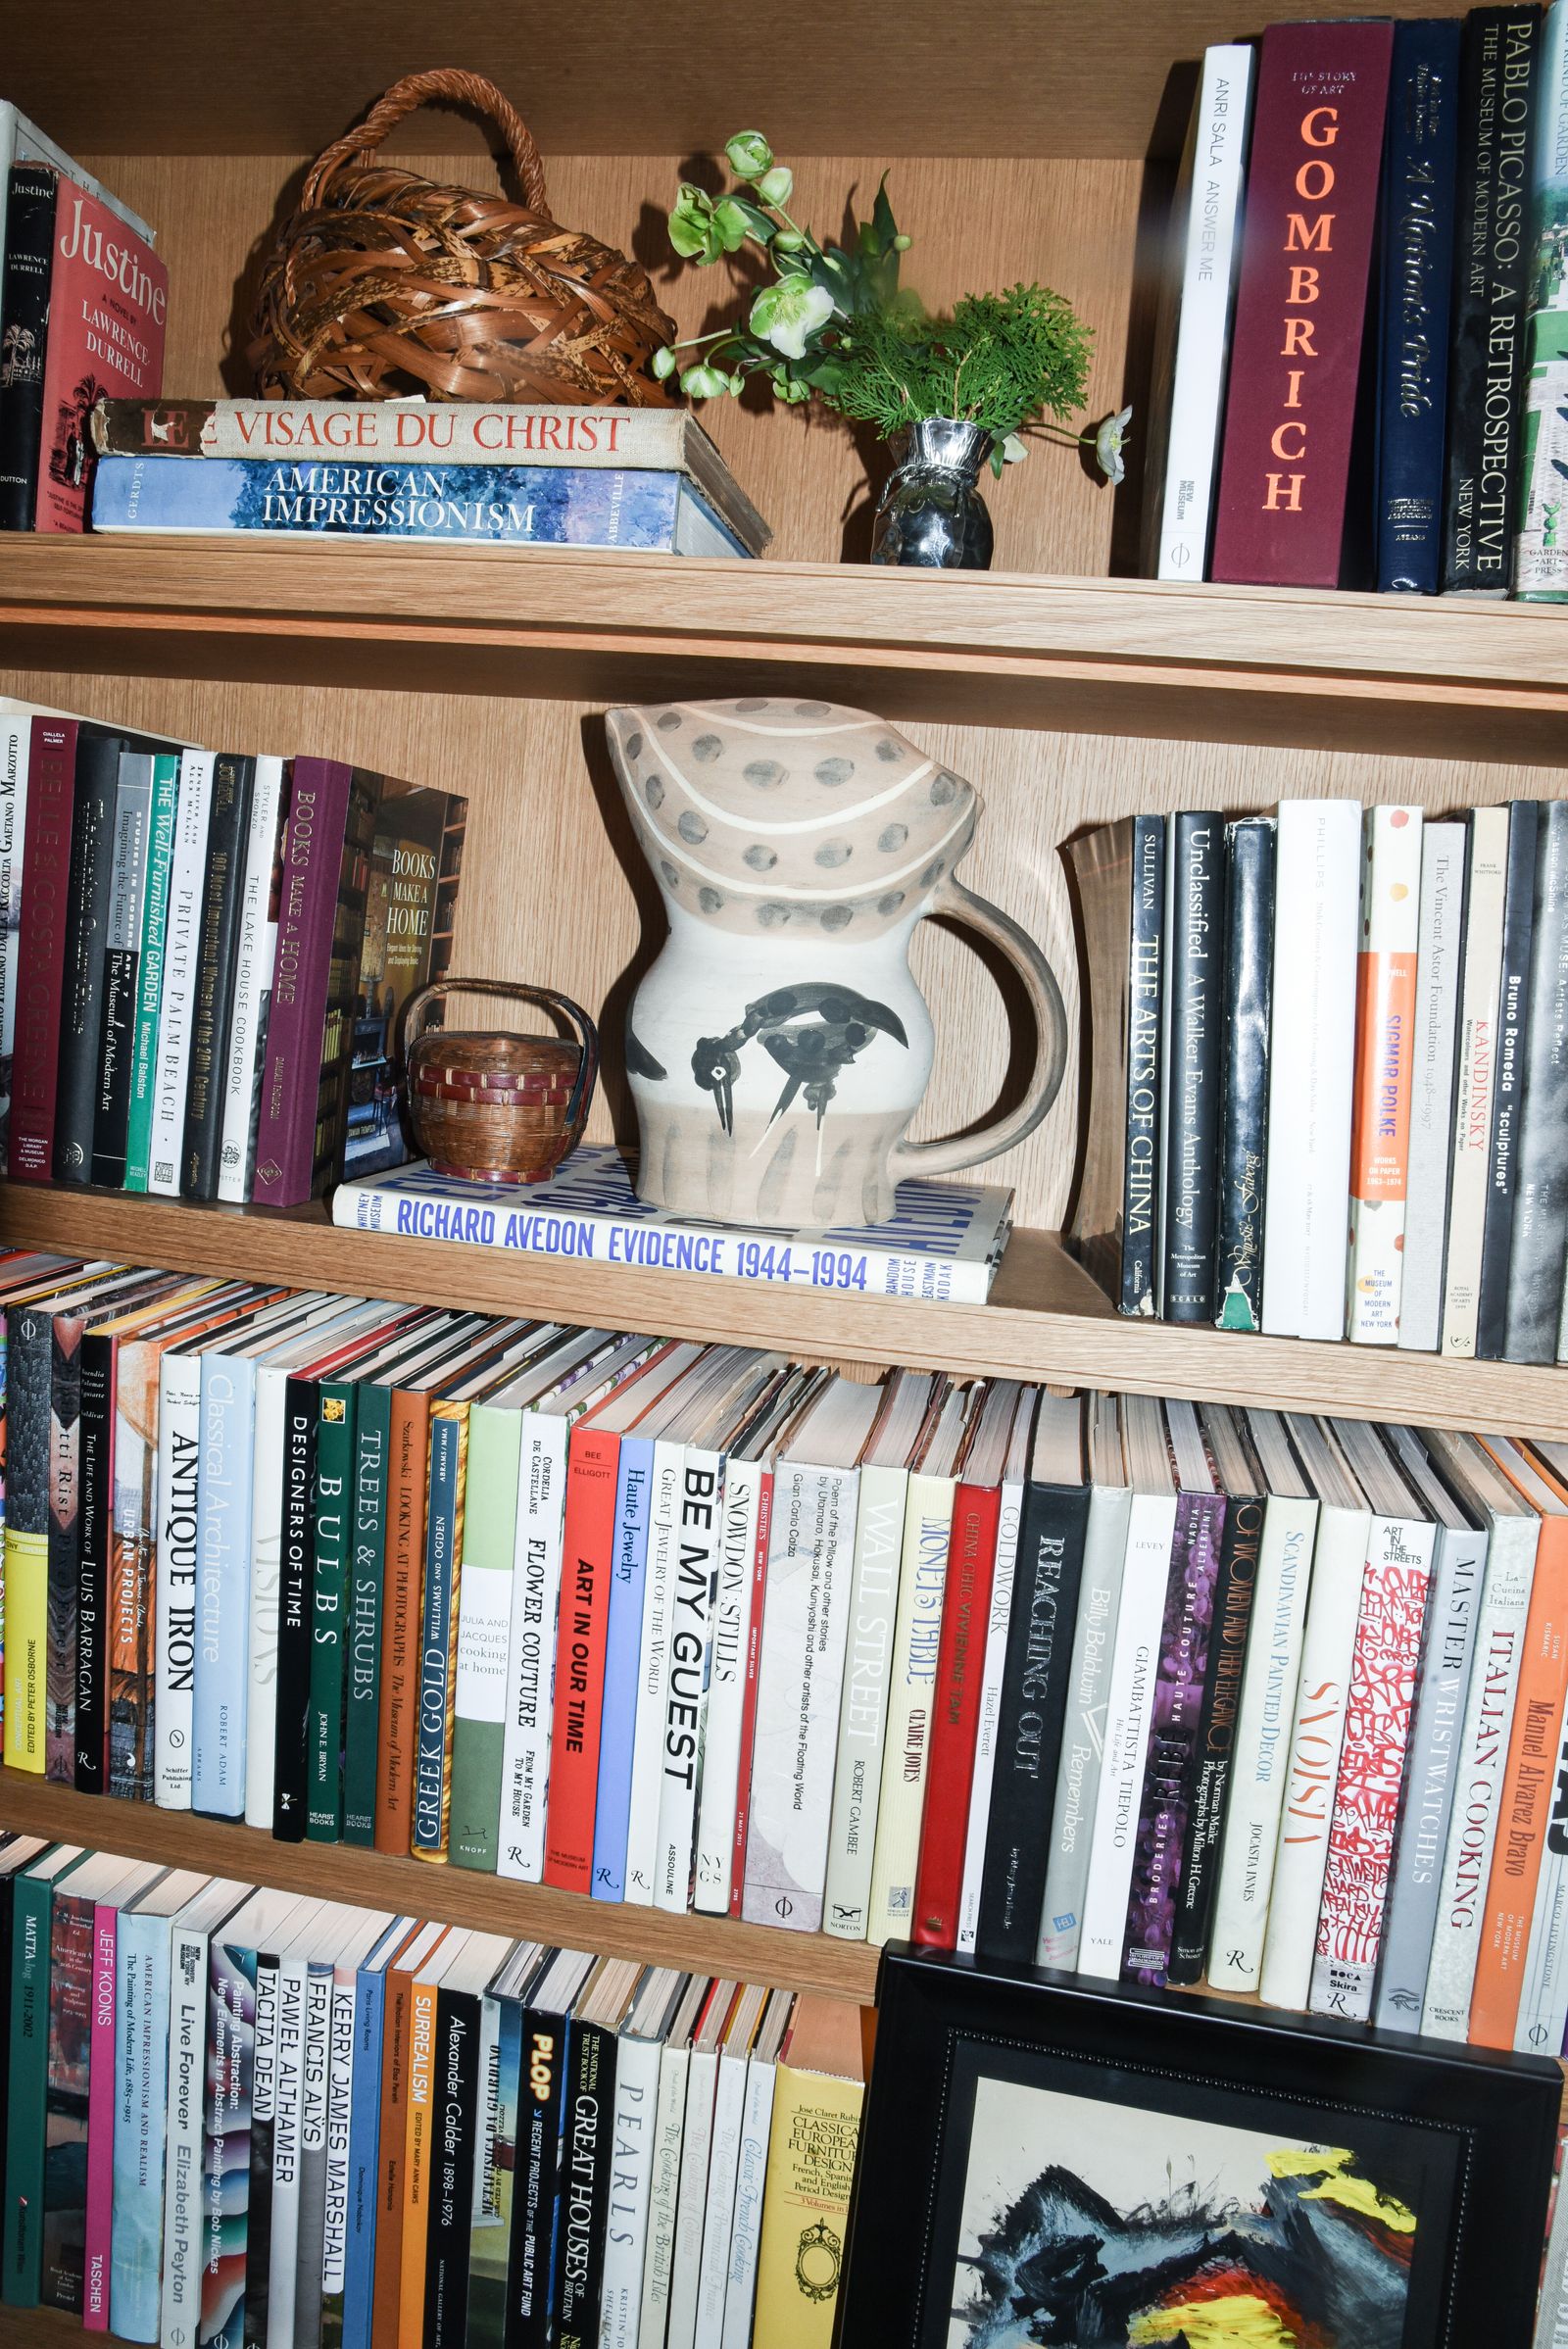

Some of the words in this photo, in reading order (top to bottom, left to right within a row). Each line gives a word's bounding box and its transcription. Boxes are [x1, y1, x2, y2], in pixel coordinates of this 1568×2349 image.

[1482, 24, 1499, 61] THE
[1501, 22, 1533, 122] PABLO
[1213, 77, 1229, 118] ANRI
[1478, 69, 1496, 146] MUSEUM
[1207, 122, 1224, 168] SALA
[1476, 152, 1490, 175] OF
[12, 181, 53, 199] Justine
[1201, 179, 1220, 254] ANSWER
[1471, 180, 1490, 256] MODERN
[1494, 131, 1527, 269] PICASSO:
[8, 253, 48, 266] LAWRENCE
[10, 264, 44, 275] DURRELL
[60, 200, 167, 325] Justine
[1198, 257, 1213, 282] ME
[1470, 263, 1484, 297] ART
[1260, 106, 1340, 512] GOMBRICH
[1492, 282, 1517, 305] A
[81, 300, 148, 366] LAWRENCE
[86, 331, 143, 388] DURRELL
[234, 411, 380, 447] VISAGE
[394, 413, 455, 448] DU
[473, 416, 631, 452] CHRIST
[1476, 315, 1515, 572] RETROSPECTIVE
[126, 462, 145, 519] GERDTS
[263, 468, 448, 497] AMERICAN
[608, 472, 624, 544] ABBEVILLE
[262, 500, 537, 533] IMPRESSIONISM
[158, 778, 172, 807] THE
[148, 813, 172, 942] Well-Furnished
[248, 875, 260, 904] THE
[392, 849, 436, 881] BOOKS
[395, 883, 417, 904] MAKE
[419, 889, 428, 904] A
[1144, 835, 1156, 909] SULLIVAN
[1188, 828, 1210, 957] Unclassified
[1436, 855, 1449, 879] The
[172, 890, 193, 978] PRIVATE
[244, 908, 256, 951] LAKE
[386, 906, 429, 936] HOME
[1433, 885, 1448, 940] Vincent
[143, 950, 161, 1012] GARDEN
[238, 954, 252, 1009] HOUSE
[1137, 934, 1159, 998] THE
[1187, 974, 1205, 986] A
[1430, 945, 1445, 982] Astor
[167, 991, 184, 1047] PALM
[1186, 993, 1205, 1063] Walker
[1427, 985, 1444, 1062] Foundation
[1505, 976, 1522, 1021] Bruno
[139, 1021, 152, 1060] Michael
[230, 1016, 247, 1096] COOKBOOK
[1134, 1009, 1156, 1080] ARTS
[1382, 1014, 1401, 1078] SIGMAR
[1501, 1028, 1518, 1092] Romeda
[136, 1062, 148, 1099] Balston
[161, 1054, 179, 1121] BEACH
[1130, 1089, 1154, 1128] OF
[1185, 1069, 1203, 1125] Evans
[1469, 1020, 1490, 1151] KANDINSKY
[1379, 1088, 1397, 1137] POLKE
[357, 1193, 369, 1230] WHITNEY
[1129, 1136, 1153, 1235] CHINA
[1176, 1131, 1201, 1230] Anthology
[369, 1195, 382, 1230] MUSEUM
[396, 1199, 495, 1245] RICHARD
[504, 1214, 594, 1257] AVEDON
[609, 1226, 724, 1274] EVIDENCE
[884, 1257, 899, 1296] RANDOM
[901, 1258, 917, 1297] HOUSE
[920, 1262, 937, 1298] EASTMAN
[938, 1263, 953, 1299] KODAK
[206, 1375, 235, 1487] Classical
[166, 1431, 199, 1587] ANTIQUE
[289, 1417, 308, 1539] DESIGNERS
[358, 1431, 381, 1531] TREES
[624, 1468, 645, 1519] Haute
[682, 1467, 715, 1530] BE
[288, 1545, 303, 1571] OF
[314, 1473, 342, 1644] BULBS
[357, 1545, 375, 1567] &
[616, 1522, 641, 1584] Jewelry
[858, 1499, 899, 1603] WALL
[991, 1506, 1020, 1636] GOLDWORK
[1383, 1552, 1422, 1564] STREETS
[1390, 1536, 1400, 1544] IN
[1391, 1544, 1406, 1553] THE
[80, 1560, 96, 1602] LUIS
[203, 1494, 231, 1663] Architecture
[287, 1579, 302, 1628] TIME
[524, 1538, 546, 1624] FLOWER
[575, 1558, 595, 1606] ART
[677, 1542, 710, 1620] MY
[1082, 1587, 1111, 1629] Billy
[1272, 1531, 1305, 1647] SCANDINAVIAN
[353, 1579, 376, 1700] SHRUBS
[572, 1611, 591, 1636] IN
[1443, 1557, 1476, 1671] MASTER
[78, 1609, 95, 1711] BARRAGAN
[168, 1605, 195, 1691] IRON
[569, 1641, 590, 1693] OUR
[1078, 1630, 1106, 1705] Baldwin
[421, 1648, 445, 1734] GOLD
[518, 1633, 541, 1728] COUTURE
[664, 1631, 704, 1790] GUEST
[847, 1615, 888, 1746] STREET
[1122, 1645, 1150, 1771] GIAMBATTISTA
[1261, 1654, 1290, 1722] PAINTED
[1474, 1630, 1515, 1768] ITALIAN
[220, 1704, 228, 1748] ROBERT
[565, 1699, 585, 1754] TIME
[1254, 1726, 1281, 1782] DECOR
[1522, 1698, 1555, 1758] Manuel
[416, 1743, 442, 1838] GREEK
[1061, 1744, 1092, 1853] Remembers
[1411, 1677, 1460, 1884] WRISTWATCHES
[1512, 1764, 1545, 1826] Alvarez
[1113, 1780, 1133, 1848] TIEPOLO
[461, 1845, 487, 1854] KNOPF
[1450, 1781, 1494, 1930] COOKING
[1504, 1827, 1536, 1877] Bravo
[100, 1930, 114, 1967] JEFF
[98, 1972, 113, 2026] KOONS
[256, 1974, 275, 2047] TACITA
[1330, 1980, 1357, 1991] Skira
[179, 2005, 195, 2046] Live
[306, 1982, 326, 2082] FRANCIS
[332, 1993, 353, 2067] KERRY
[412, 1996, 431, 2103] SURREALISM
[446, 2015, 466, 2098] Alexander
[176, 2051, 194, 2130] Forever
[253, 2057, 272, 2114] DEAN
[529, 2033, 554, 2101] PLOP
[275, 2061, 298, 2182] ALTHAMER
[304, 2090, 325, 2143] ALŸS
[329, 2074, 349, 2150] JAMES
[444, 2102, 462, 2156] Calder
[571, 2095, 599, 2180] GREAT
[175, 2144, 191, 2233] Elizabeth
[610, 2082, 644, 2246] PEARLS
[323, 2160, 346, 2281] MARSHALL
[565, 2183, 593, 2282] HOUSES
[90, 2255, 102, 2313] TASCHEN
[172, 2234, 188, 2304] Peyton
